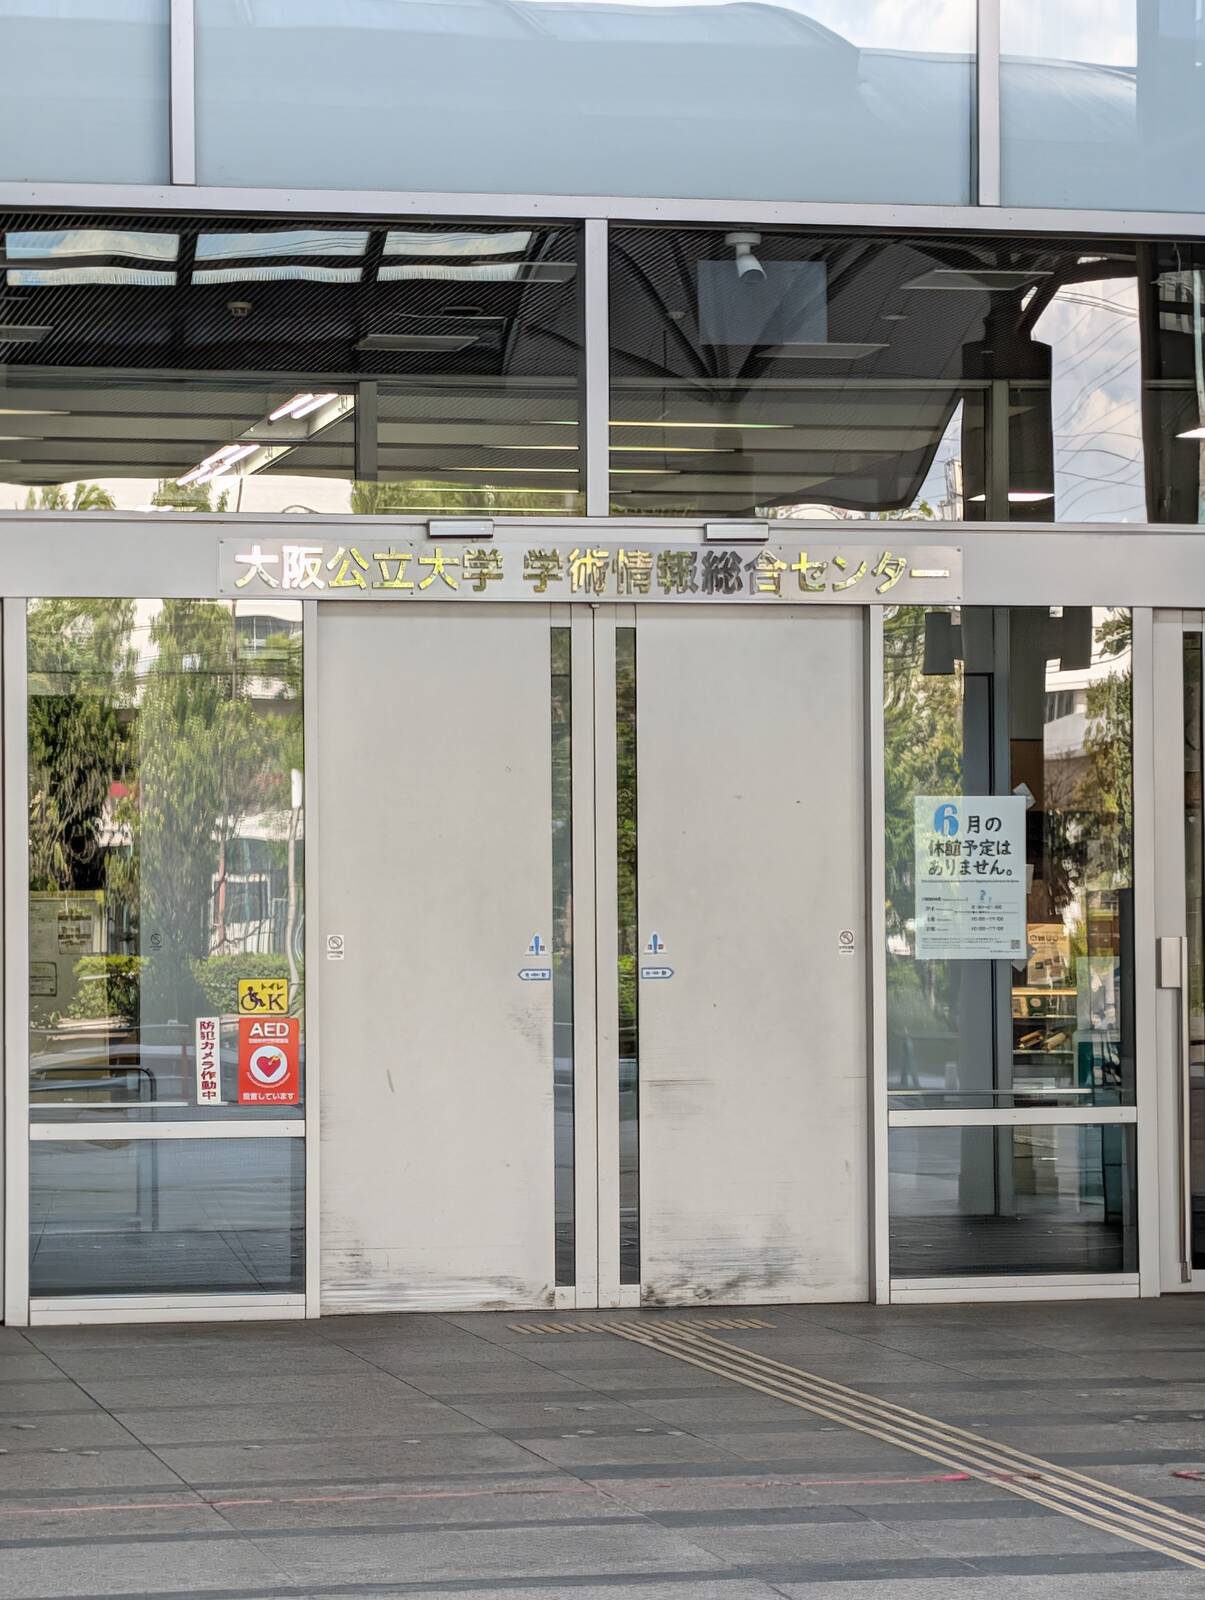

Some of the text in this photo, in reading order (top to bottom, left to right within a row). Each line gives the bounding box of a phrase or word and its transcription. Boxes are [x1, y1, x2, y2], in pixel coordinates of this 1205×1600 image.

[234, 545, 950, 595] 大阪公立大学 学術情報総合センター
[934, 803, 1002, 837] 6月の
[928, 839, 1012, 858] 休館予定は
[928, 859, 1013, 877] ありません。
[260, 982, 284, 991] トイレ
[249, 1022, 290, 1038] AED
[200, 1021, 217, 1100] 防犯カメラ作動中
